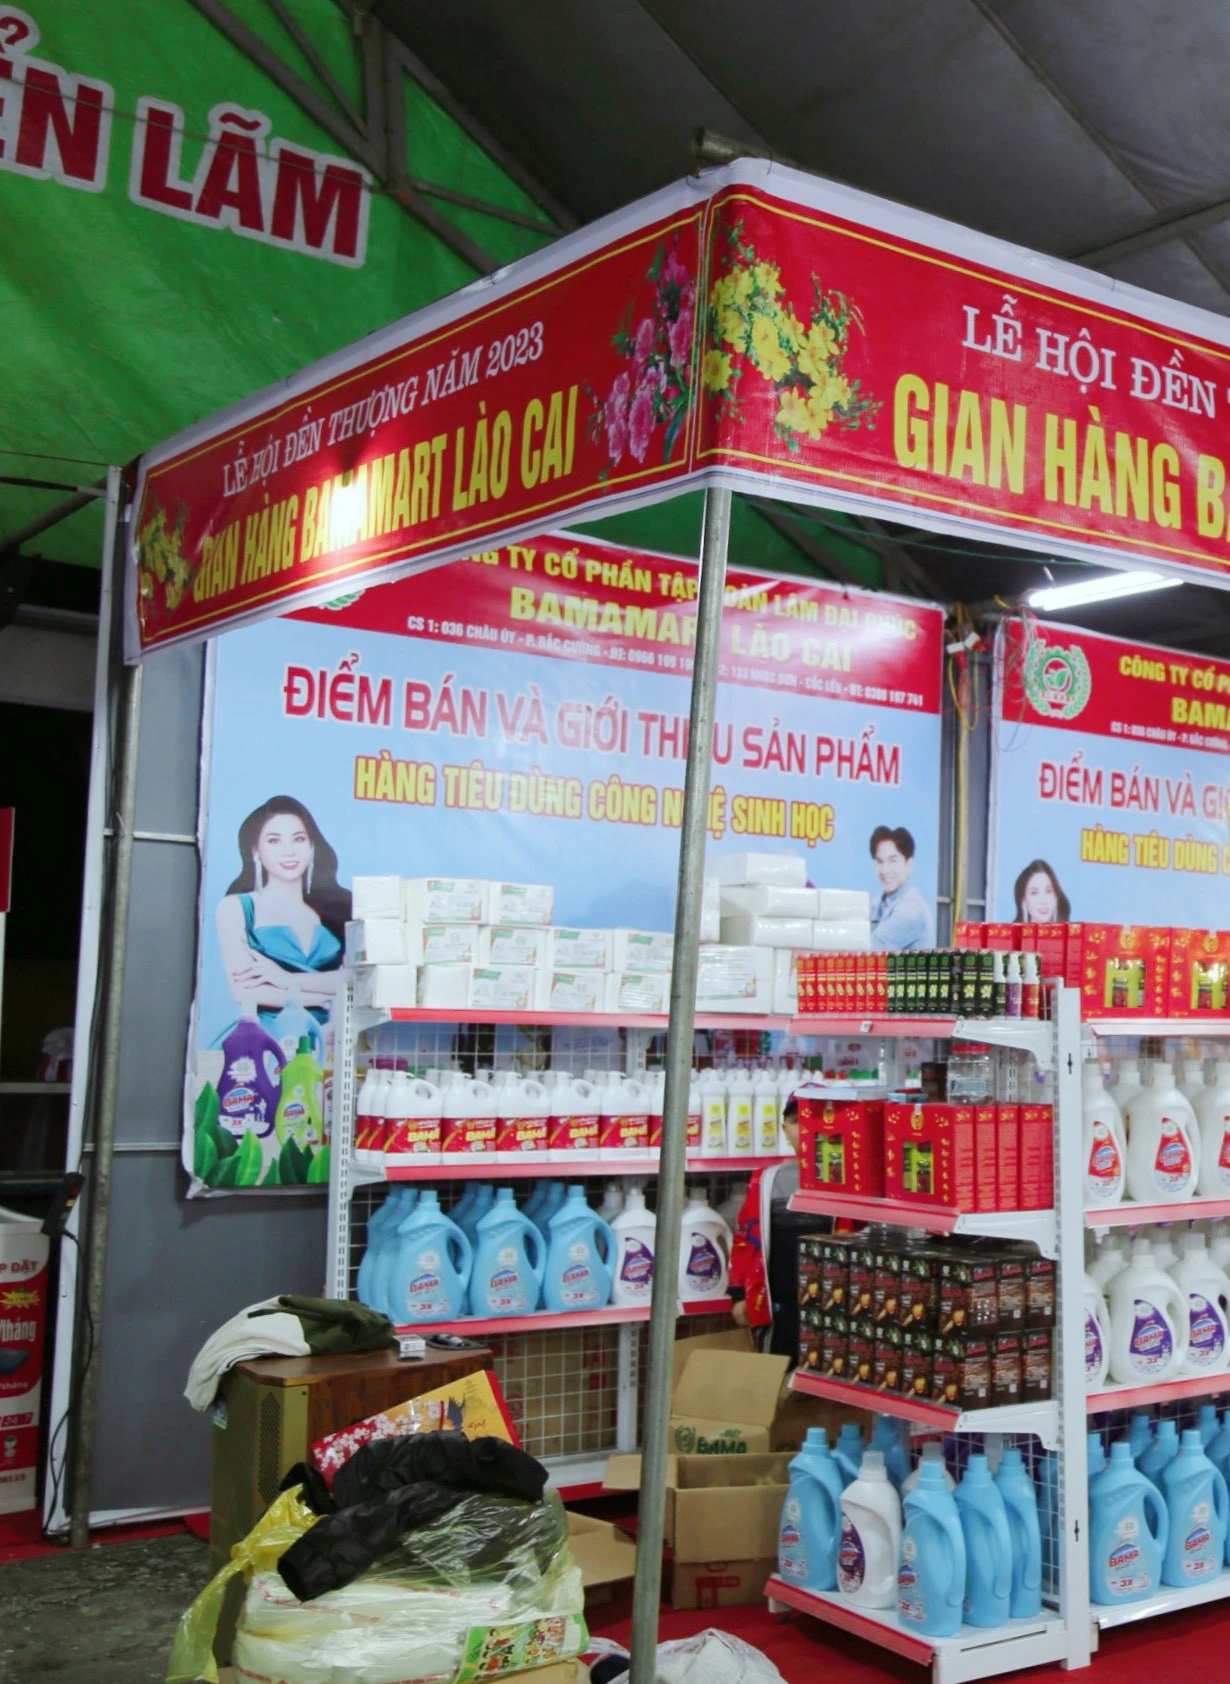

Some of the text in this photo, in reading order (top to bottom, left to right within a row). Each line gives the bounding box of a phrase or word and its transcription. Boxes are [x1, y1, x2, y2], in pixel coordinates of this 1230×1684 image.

[139, 106, 362, 258] LÃM
[250, 429, 281, 486] HỘI
[284, 405, 324, 465] ĐỀN
[327, 376, 418, 444] THƯỢNG
[421, 345, 483, 405] NĂM
[487, 322, 544, 377] 2023
[963, 293, 1024, 363] LỄ
[1036, 327, 1117, 394] HỘI
[1131, 349, 1216, 419] ĐỀN
[241, 492, 299, 586] HÀNG
[452, 401, 512, 512] LÀO
[520, 385, 578, 489] CAI
[894, 373, 1028, 494] GIAN
[1043, 405, 1182, 531] HÀNG
[507, 544, 537, 572] TY
[544, 548, 579, 579] CỔ
[586, 559, 651, 593] PHẦN
[659, 572, 698, 603] TẬP
[724, 584, 767, 613] OÀN
[774, 593, 818, 624] LÂM
[510, 586, 851, 673] BAMAMAR LÀO CAI
[283, 651, 900, 785] ĐIỂM BÁN VÀ GIỚI THIU SẢN PHẨM
[1120, 654, 1166, 682] CÔNG
[1169, 664, 1189, 686] TY
[1191, 665, 1216, 690] CỔ
[354, 749, 835, 848] HÀNG TIÊU DÙNG CÔNG NỆ SINH HỌC
[1039, 751, 1102, 805] ĐIỂM
[1110, 764, 1157, 812] BÁN
[1164, 770, 1197, 816] VÀ
[1081, 823, 1128, 865] HÀNG
[1134, 835, 1170, 869] TIÊU
[1174, 833, 1218, 874] DÙNG
